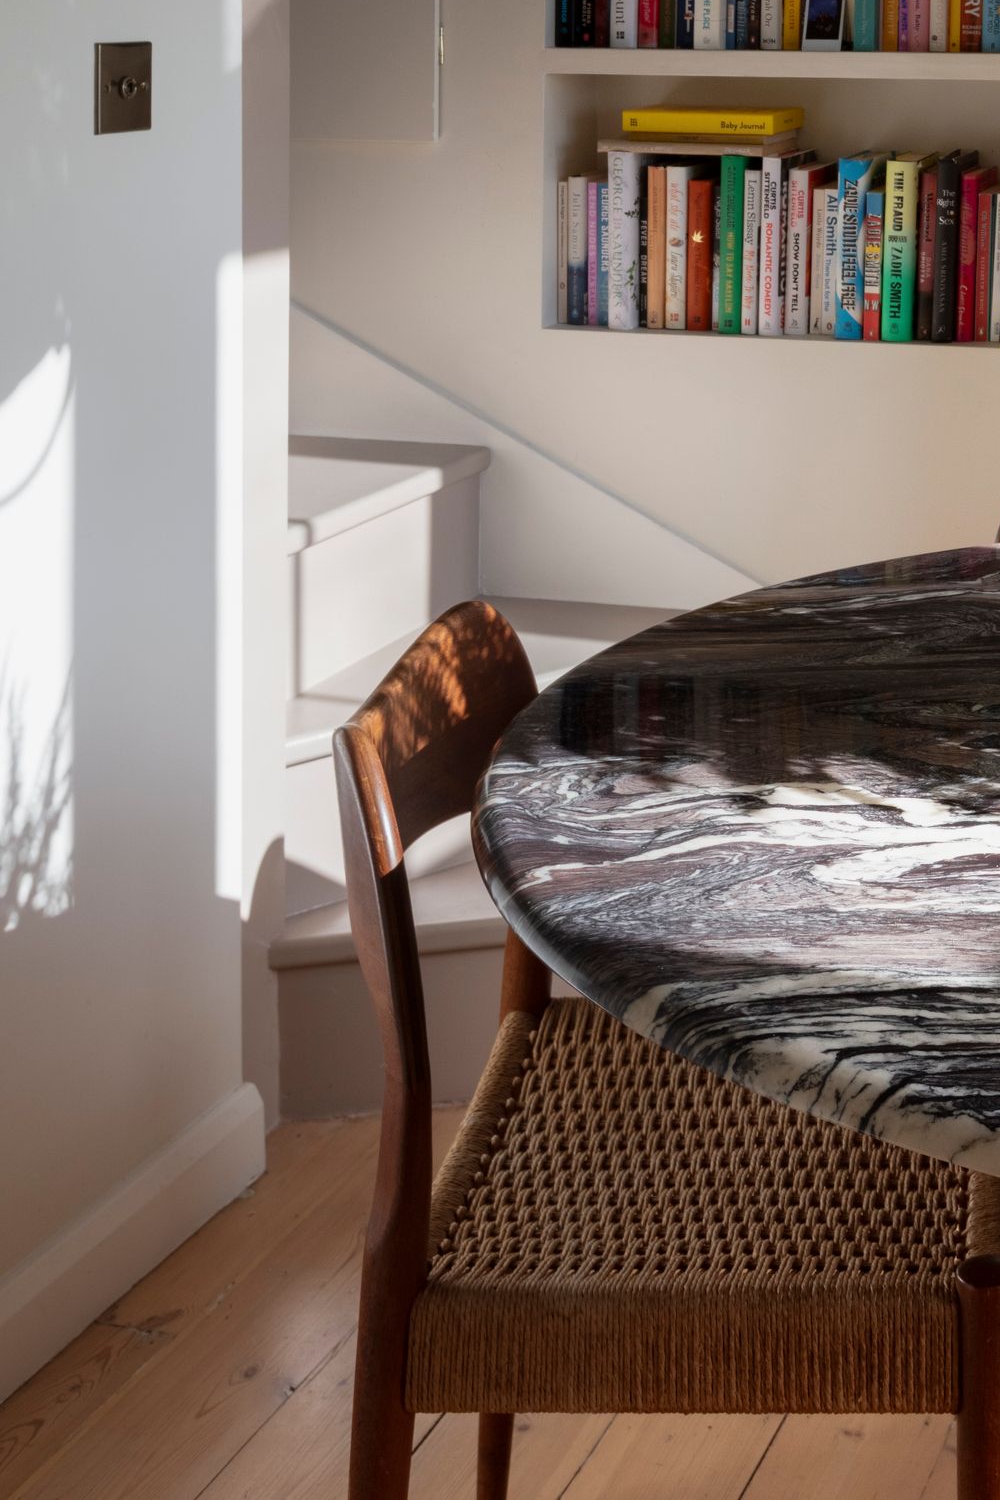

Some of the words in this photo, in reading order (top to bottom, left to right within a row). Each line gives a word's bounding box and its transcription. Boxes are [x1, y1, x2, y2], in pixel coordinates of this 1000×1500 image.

[765, 14, 773, 26] Orr
[721, 121, 738, 131] Baby
[740, 121, 765, 131] Journal
[612, 157, 623, 212] GEORGE
[747, 180, 757, 210] Lemn
[763, 172, 772, 218] SITTENFELD
[844, 180, 858, 212] ZADIE
[893, 171, 904, 191] THE
[601, 188, 609, 222] GEORGE
[827, 194, 838, 211] Ali
[892, 196, 903, 231] FRAUD
[937, 198, 955, 208] Right
[745, 212, 756, 245] Sissay
[826, 216, 838, 255] Smith
[842, 214, 857, 253] SMITH
[867, 213, 881, 247] ZADIE
[939, 216, 954, 225] Sex
[601, 225, 609, 271] SAUNDERS
[764, 223, 773, 272] ROMANTIC
[792, 232, 800, 260] SHOW
[940, 241, 948, 259] AMIA
[612, 235, 623, 306] SAUNDERS
[791, 263, 799, 289] DON'T
[842, 256, 857, 279] FEEL
[866, 252, 881, 287] SMITH
[891, 247, 903, 278] ZADIE
[763, 276, 773, 316] COMEDY
[842, 282, 856, 311] FREE
[889, 282, 902, 318] SMITH
[938, 264, 947, 312] SRINIVASAN
[865, 300, 879, 311] NW
